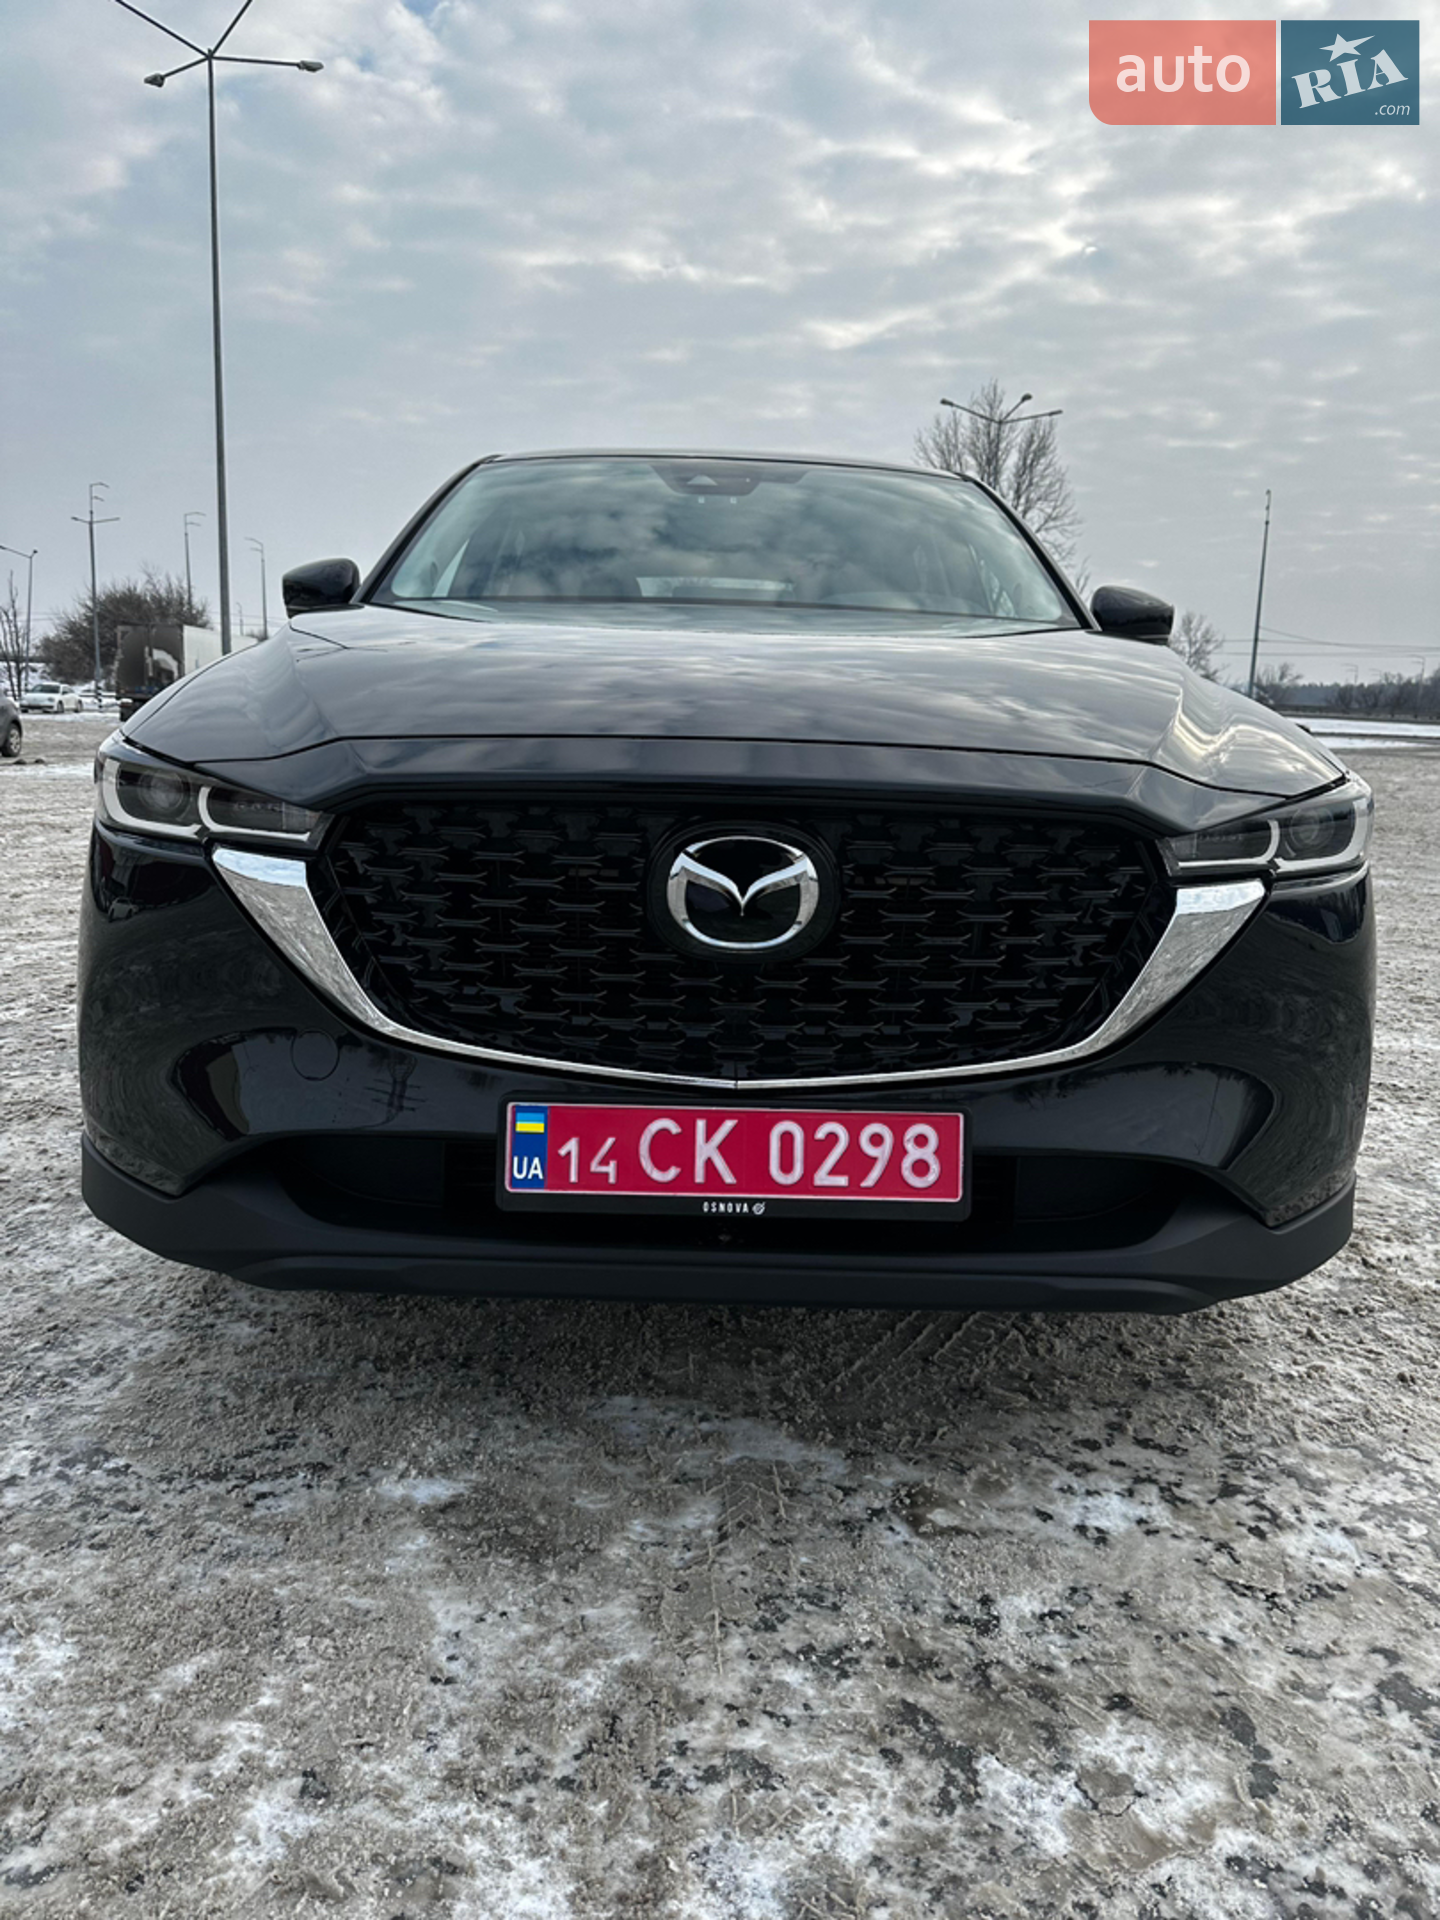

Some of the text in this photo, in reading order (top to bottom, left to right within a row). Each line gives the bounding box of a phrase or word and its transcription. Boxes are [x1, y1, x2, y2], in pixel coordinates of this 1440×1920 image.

[557, 1117, 941, 1189] 14 CK 0298
[513, 1155, 543, 1180] UA
[702, 1201, 749, 1214] OSNOVA
